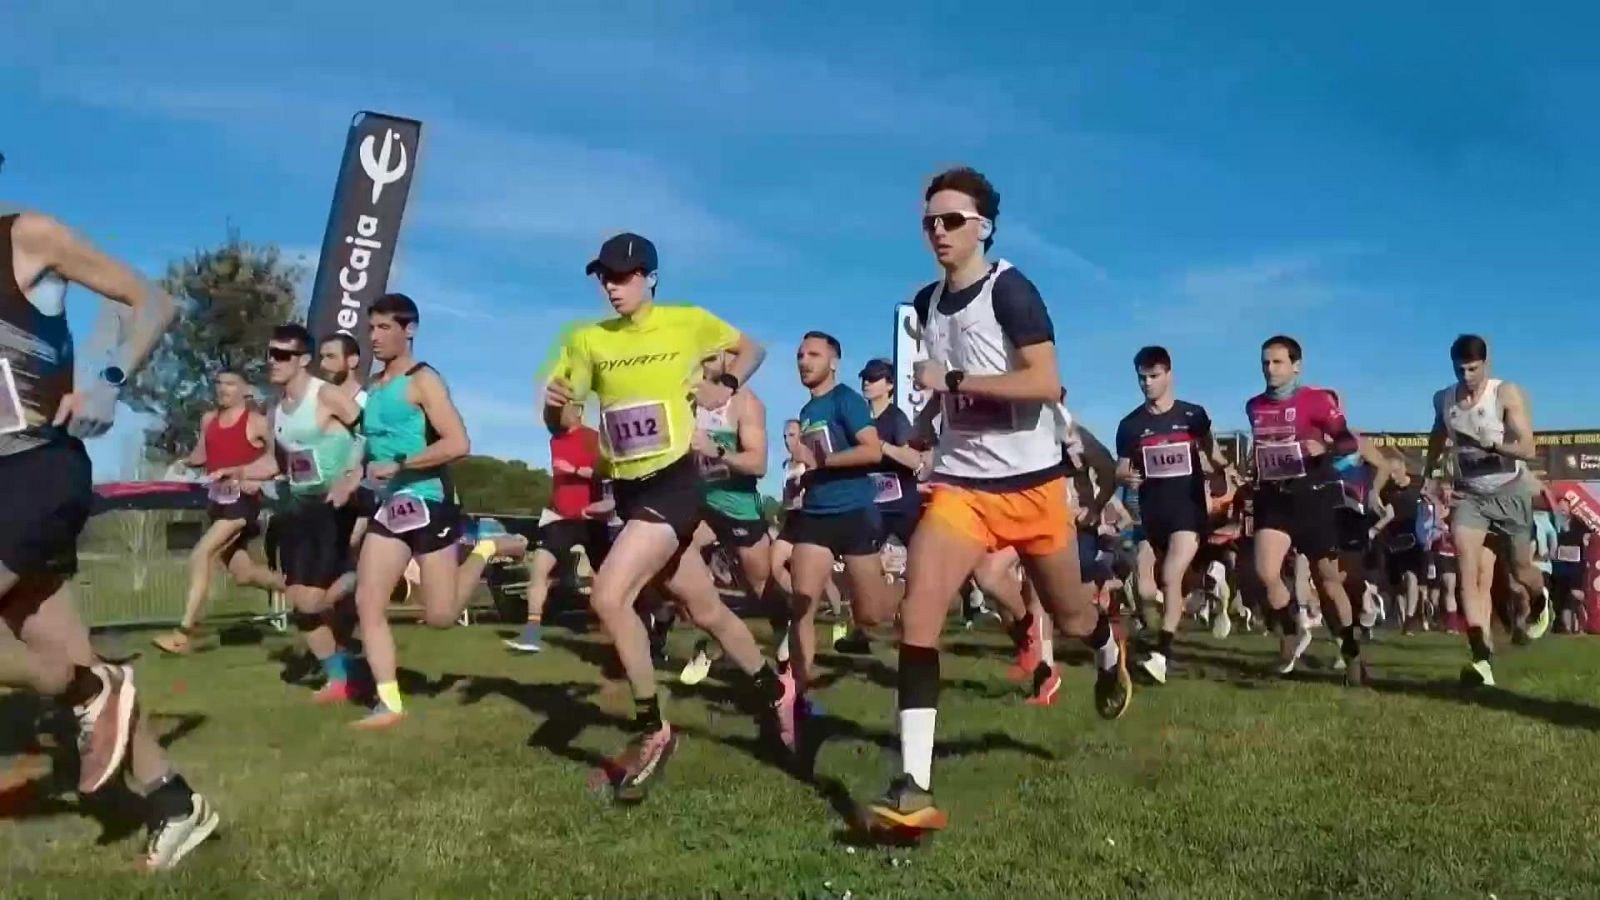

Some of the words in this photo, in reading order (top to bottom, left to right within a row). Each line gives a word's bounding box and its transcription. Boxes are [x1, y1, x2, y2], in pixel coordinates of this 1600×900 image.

[336, 214, 381, 338] erCaja
[615, 418, 658, 441] 1112
[391, 502, 416, 519] 141
